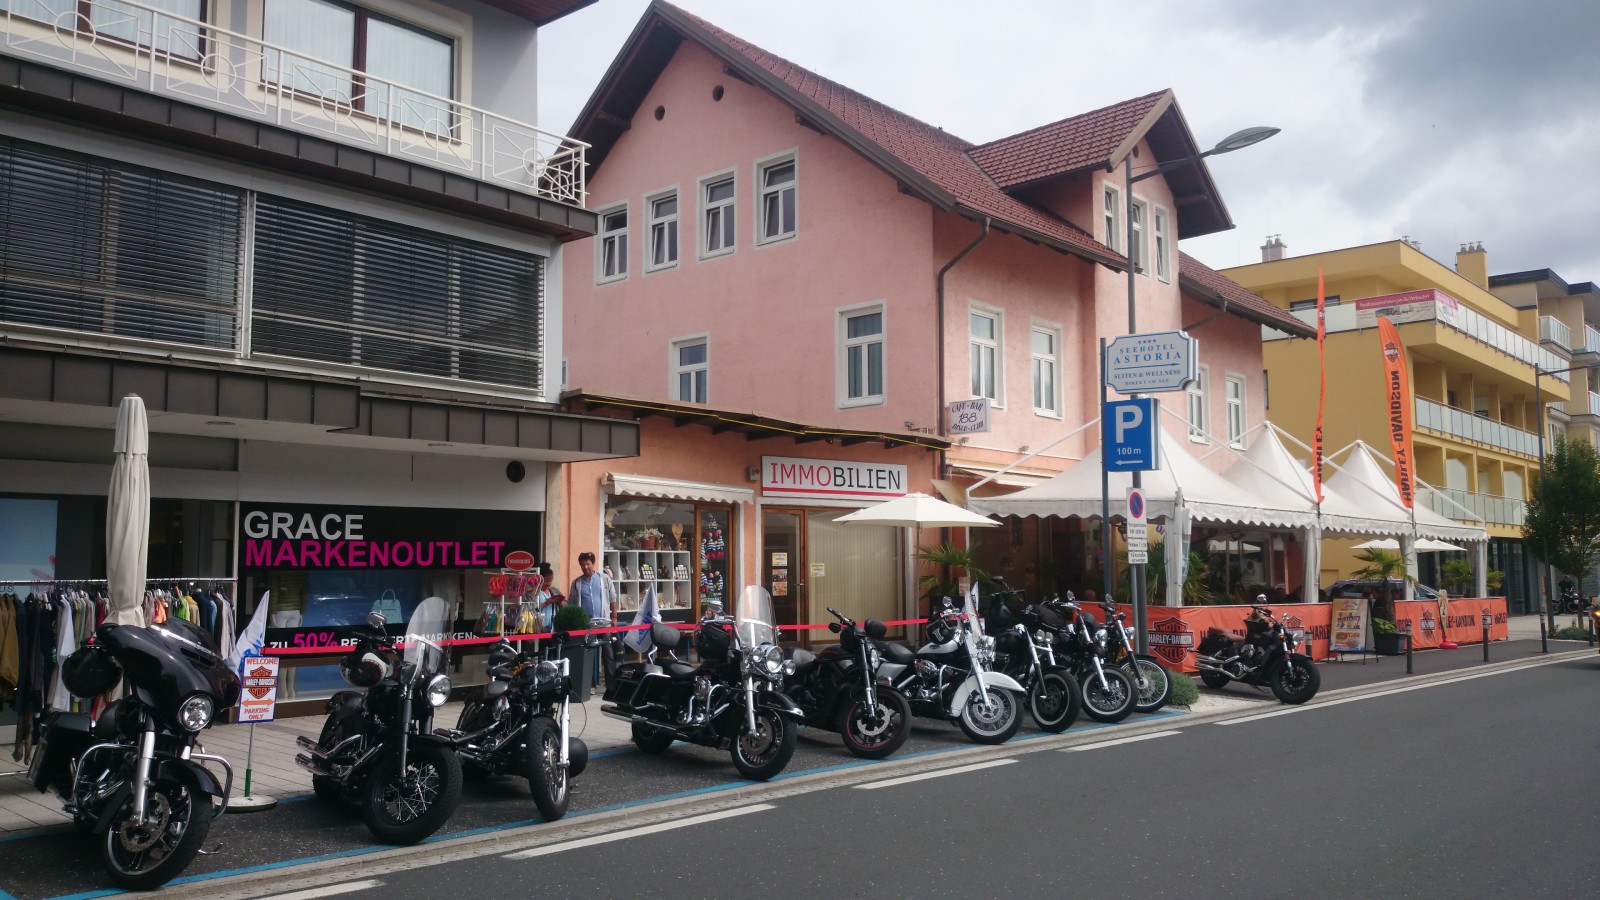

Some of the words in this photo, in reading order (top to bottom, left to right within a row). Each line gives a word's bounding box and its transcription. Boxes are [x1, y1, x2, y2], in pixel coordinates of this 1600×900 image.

[1119, 343, 1176, 354] SEEHOTEL
[1113, 351, 1182, 365] ASTORIA
[1145, 369, 1181, 378] WELLNESS
[1115, 405, 1143, 444] P
[1116, 447, 1132, 455] 100
[770, 462, 901, 490] IMMOBILIEN
[243, 510, 364, 540] GRACE
[245, 539, 505, 567] MARKENOUTLET
[293, 631, 339, 648] 50%
[246, 657, 278, 665] WELCOME
